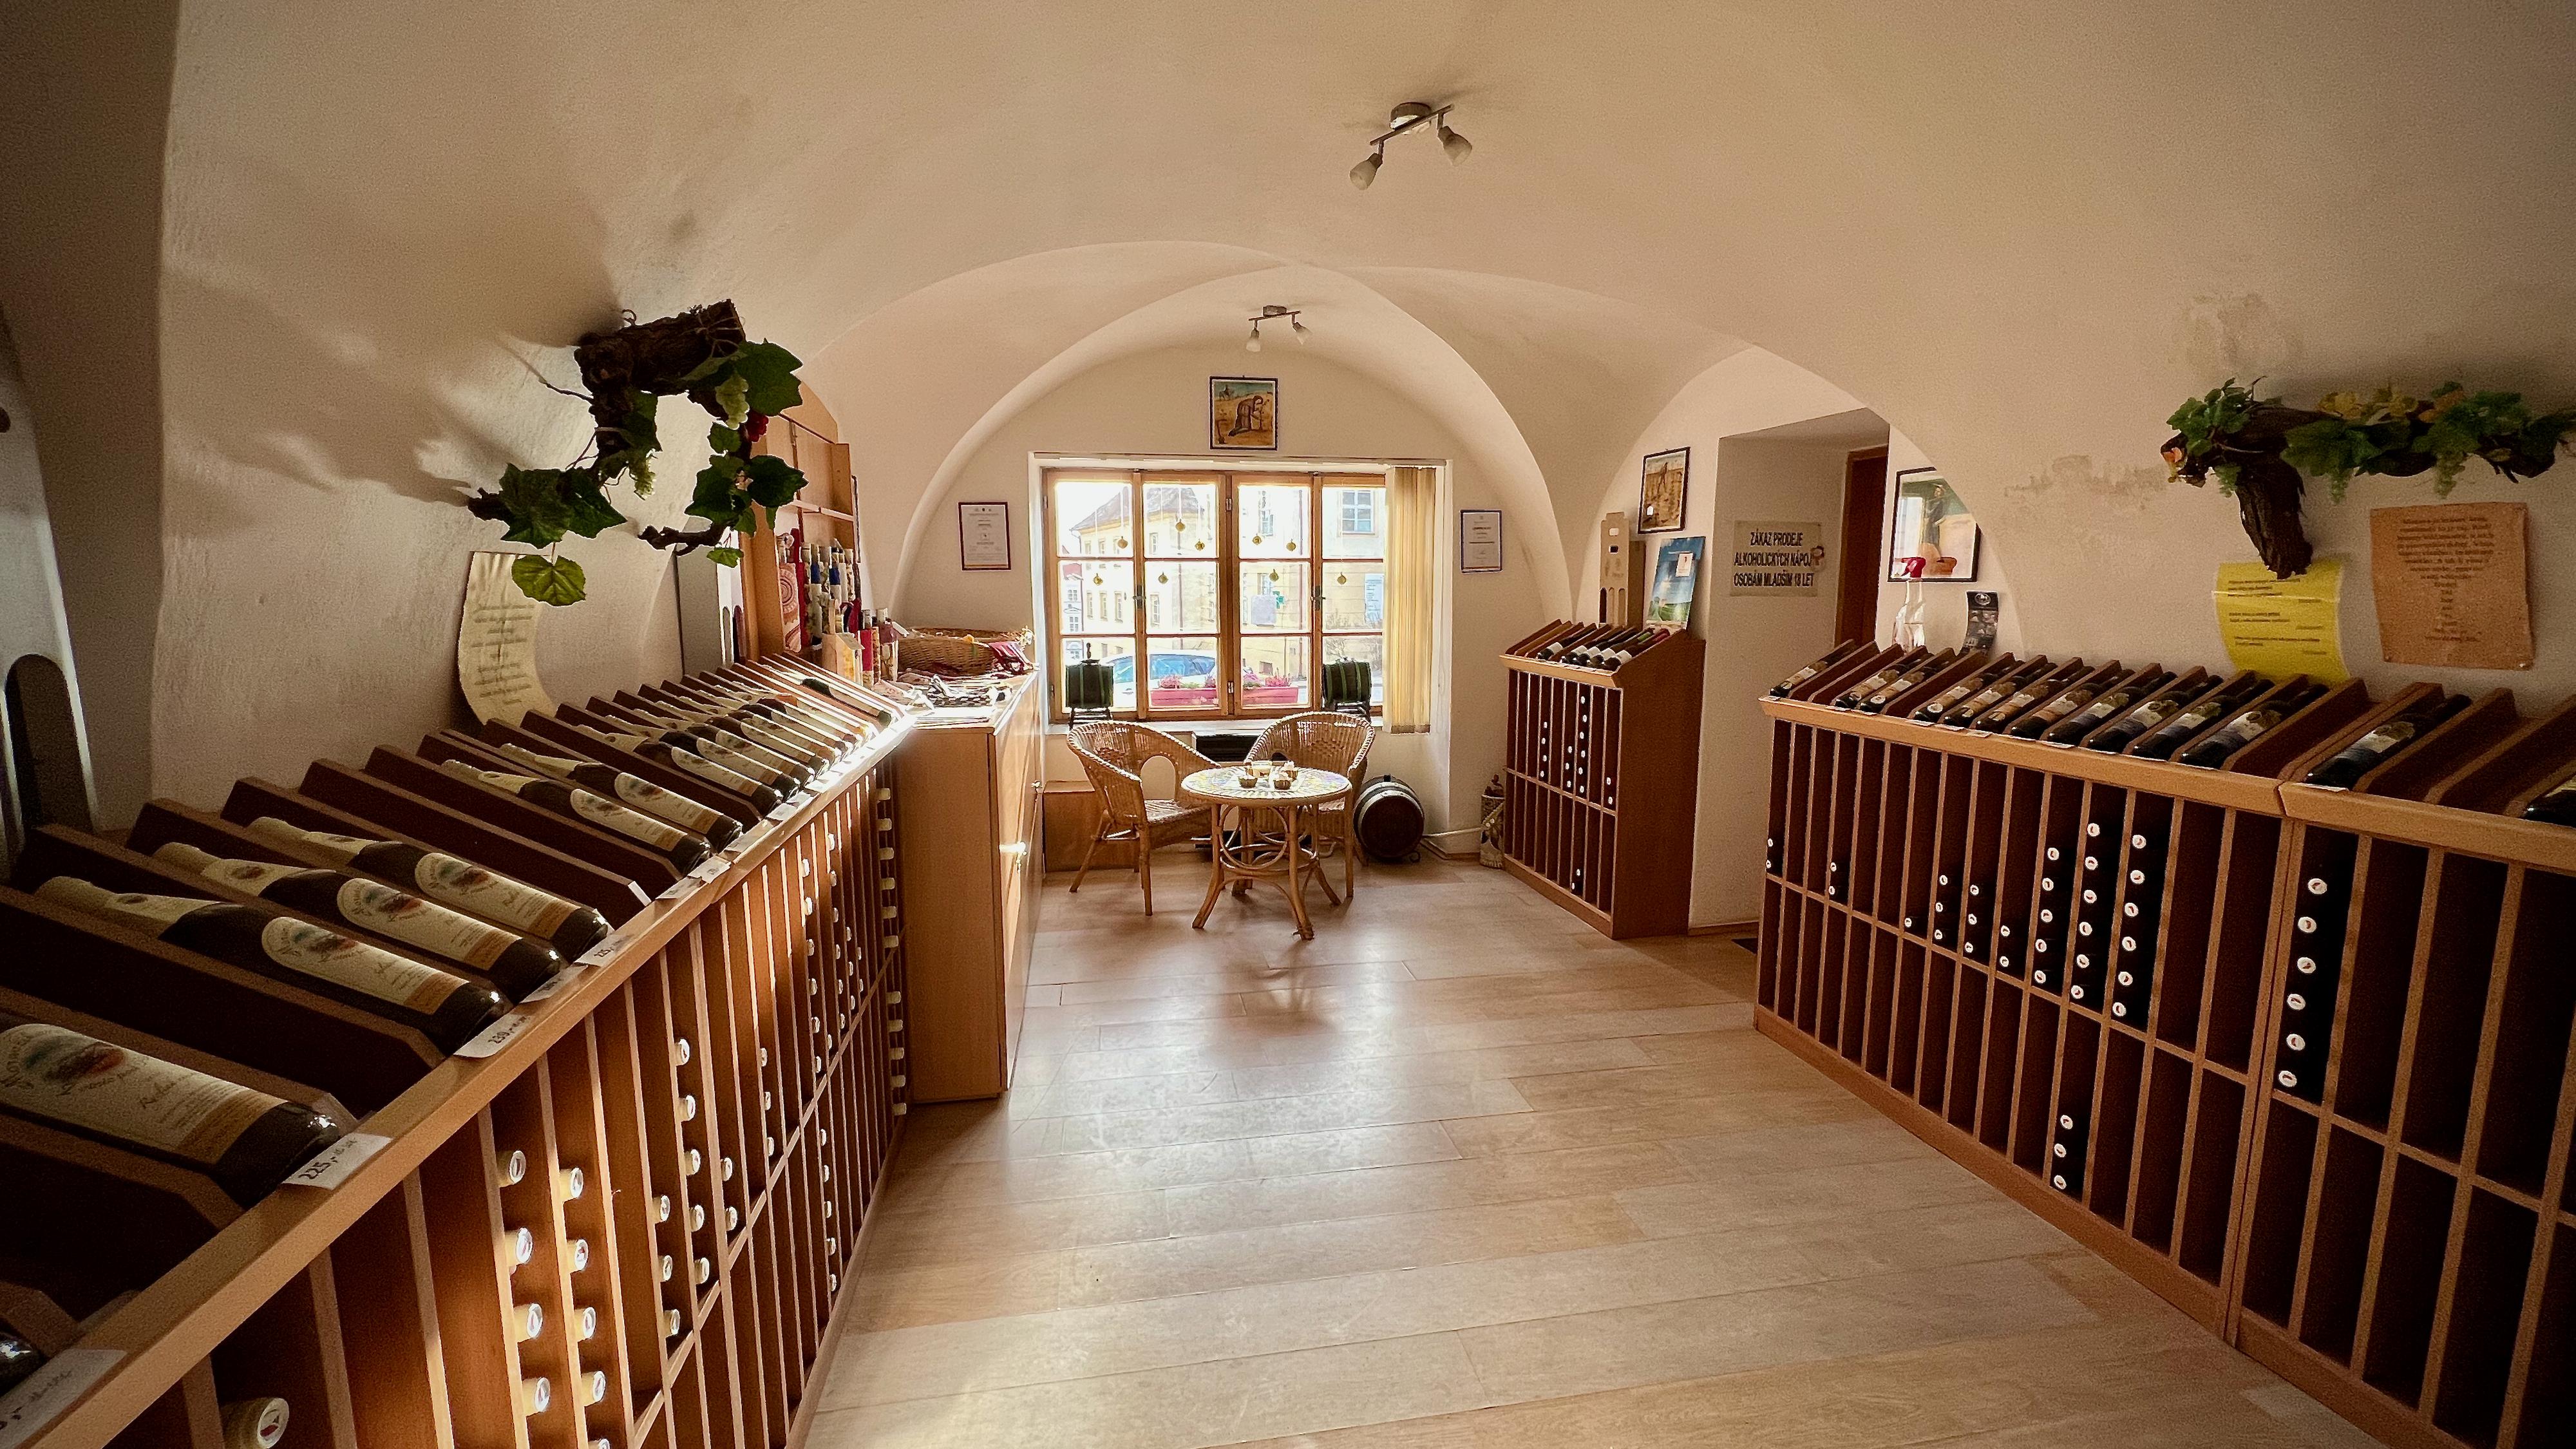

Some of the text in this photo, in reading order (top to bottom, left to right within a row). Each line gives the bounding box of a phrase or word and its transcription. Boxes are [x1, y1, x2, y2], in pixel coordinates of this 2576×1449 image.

[1750, 528, 1803, 546] ZÁKAZ PRODEJE
[1734, 549, 1817, 567] ALKOHOLICKÝCH NÁPOJ
[1734, 569, 1763, 586] OSOBÁM
[1802, 573, 1814, 586] LET
